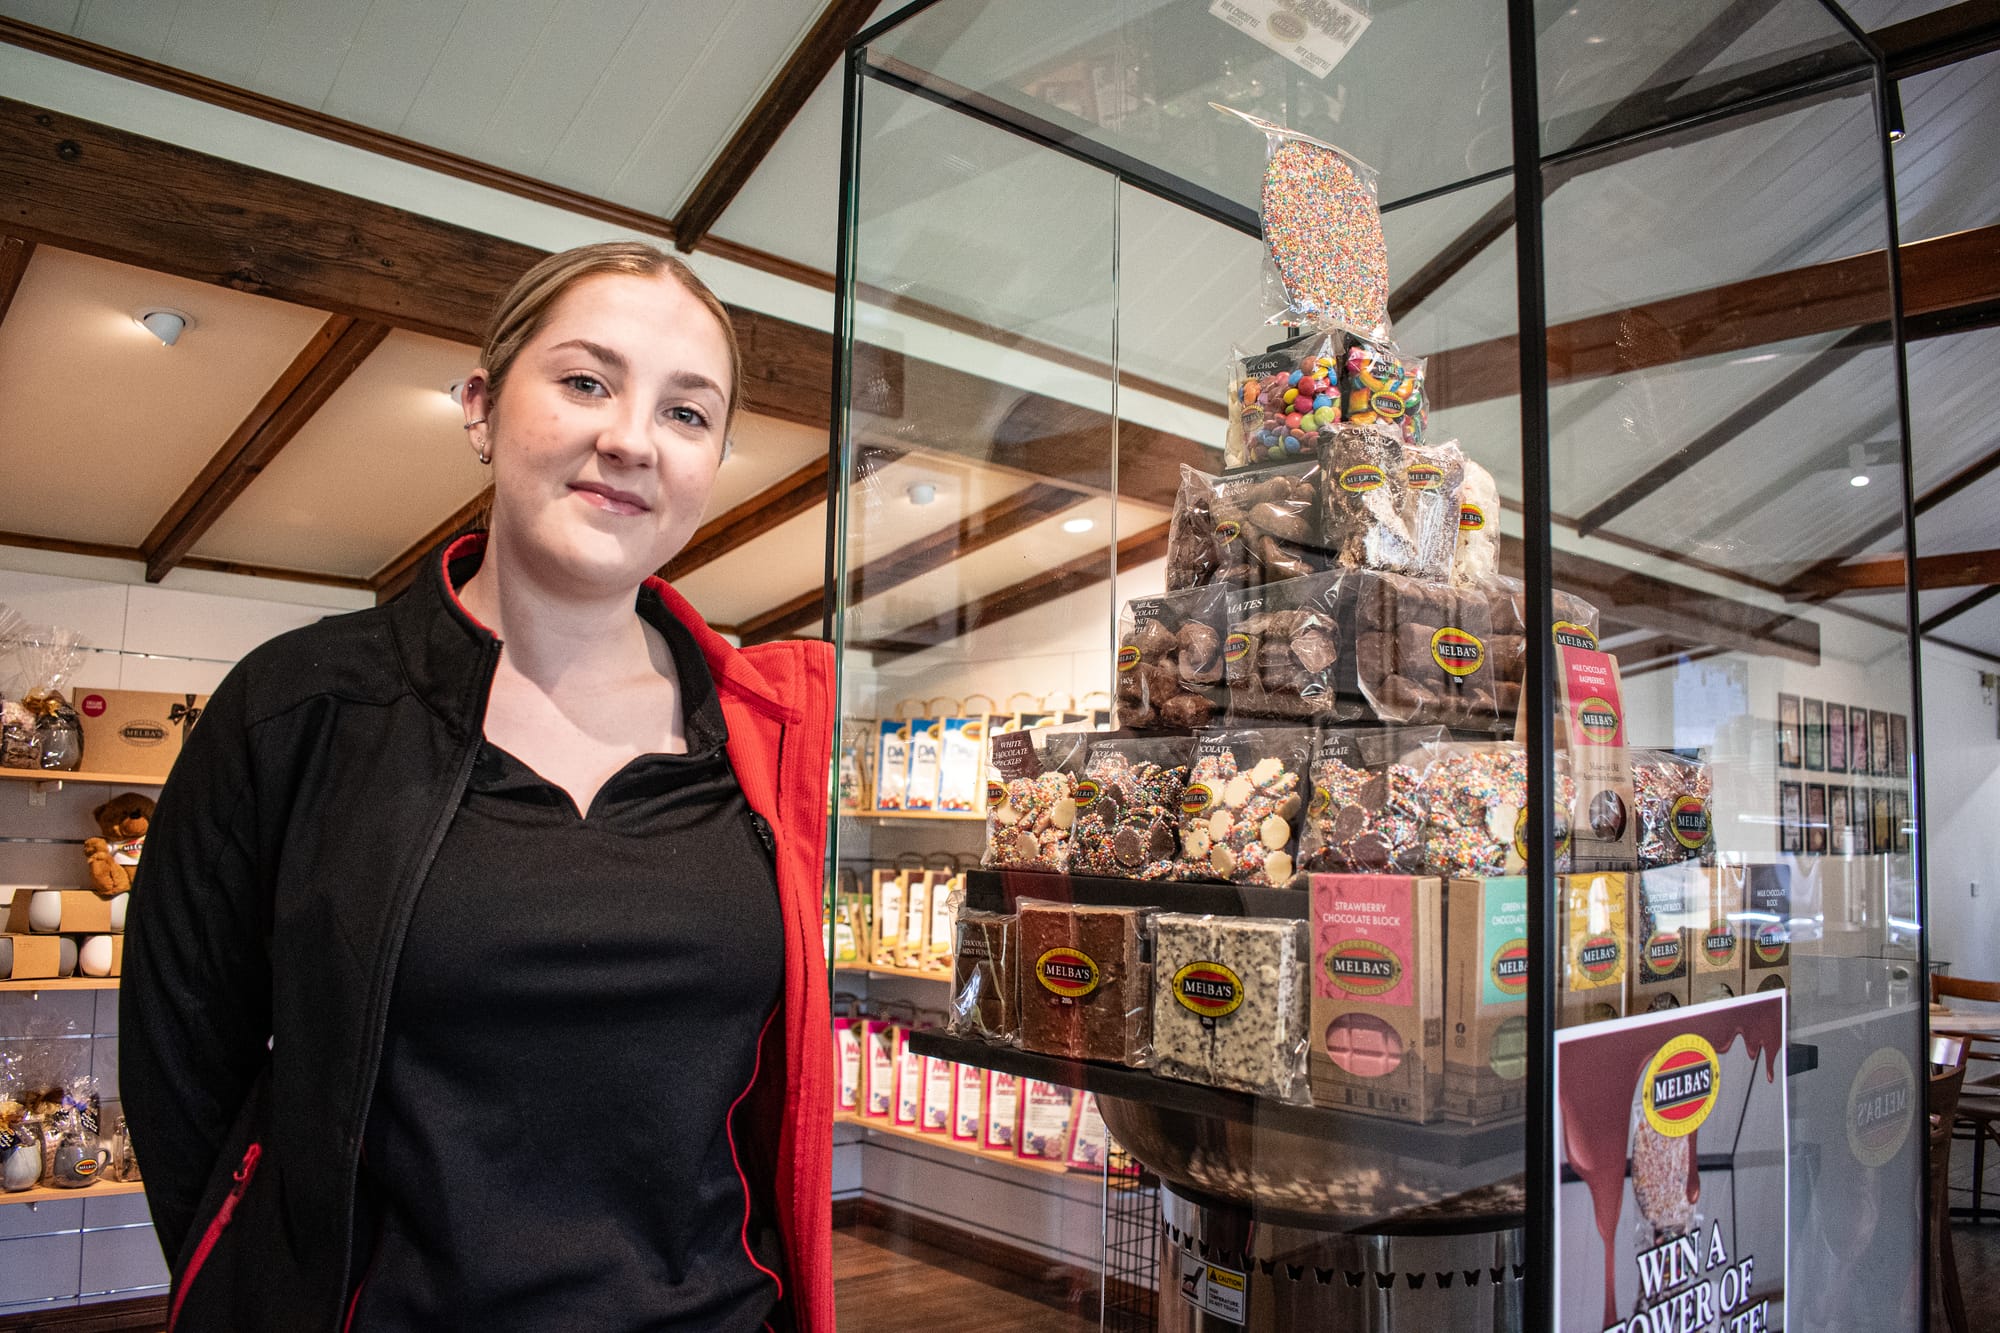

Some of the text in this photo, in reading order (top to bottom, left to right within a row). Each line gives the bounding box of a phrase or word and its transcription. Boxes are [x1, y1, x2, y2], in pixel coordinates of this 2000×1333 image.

[1557, 634, 1595, 650] MELBA'S
[1438, 643, 1478, 658] MELBA'S
[1583, 713, 1614, 726] MELBA'S
[1334, 901, 1387, 913] STRAWBERRY
[1322, 912, 1401, 926] CHOCOLATE BLOCK
[962, 940, 989, 948] CHOCOLAT
[1650, 943, 1679, 957] MELBA'S
[1707, 937, 1733, 948] MELBA'S
[1583, 947, 1616, 962] MELBA'S
[1046, 963, 1090, 980] MELBA'S
[1334, 959, 1391, 976] MELBA'S
[1184, 980, 1232, 998] MELBA'S
[1655, 1069, 1710, 1102] MELBA'S
[1637, 1221, 1727, 1299] WIN A
[1719, 1257, 1754, 1313] OF
